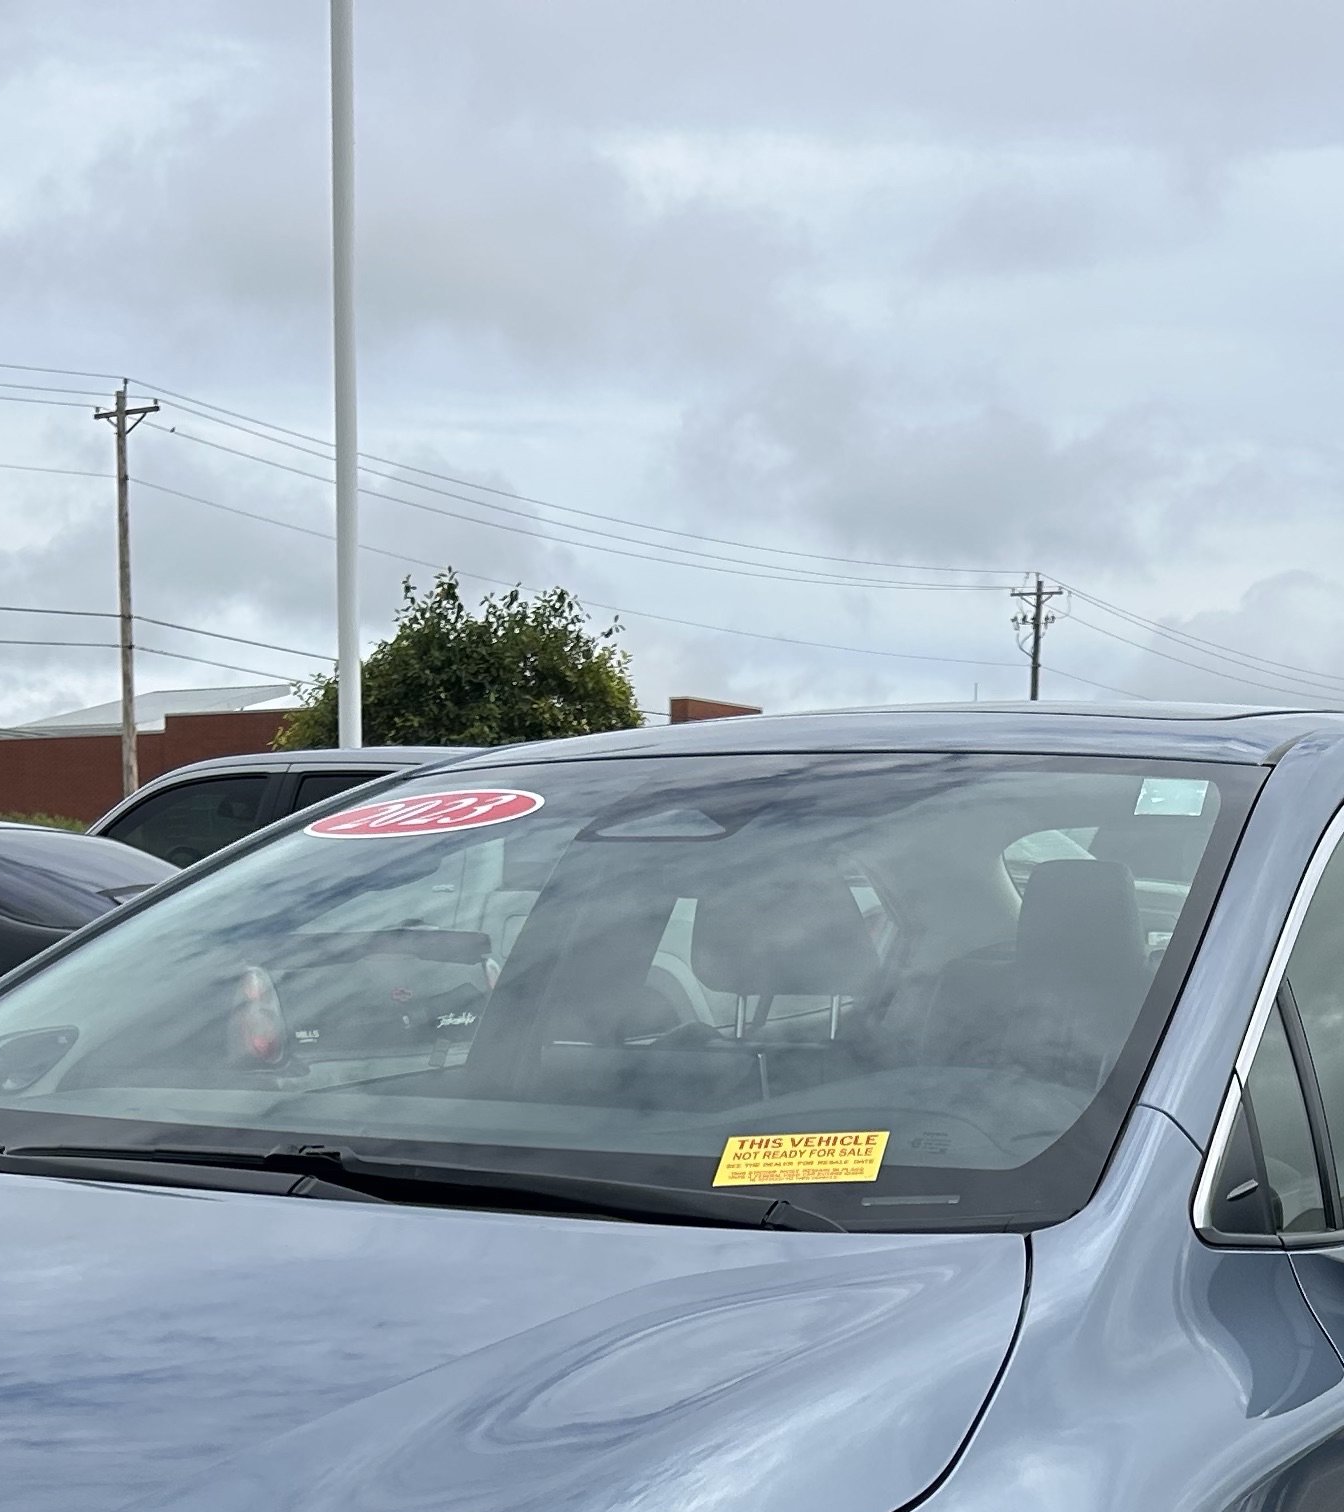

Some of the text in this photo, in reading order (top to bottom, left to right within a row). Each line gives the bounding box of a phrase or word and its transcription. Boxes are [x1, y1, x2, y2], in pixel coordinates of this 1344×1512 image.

[327, 794, 518, 831] 2023
[738, 1134, 879, 1150] THIS VEHICLE
[732, 1147, 873, 1161] NOT READY FOR SALE
